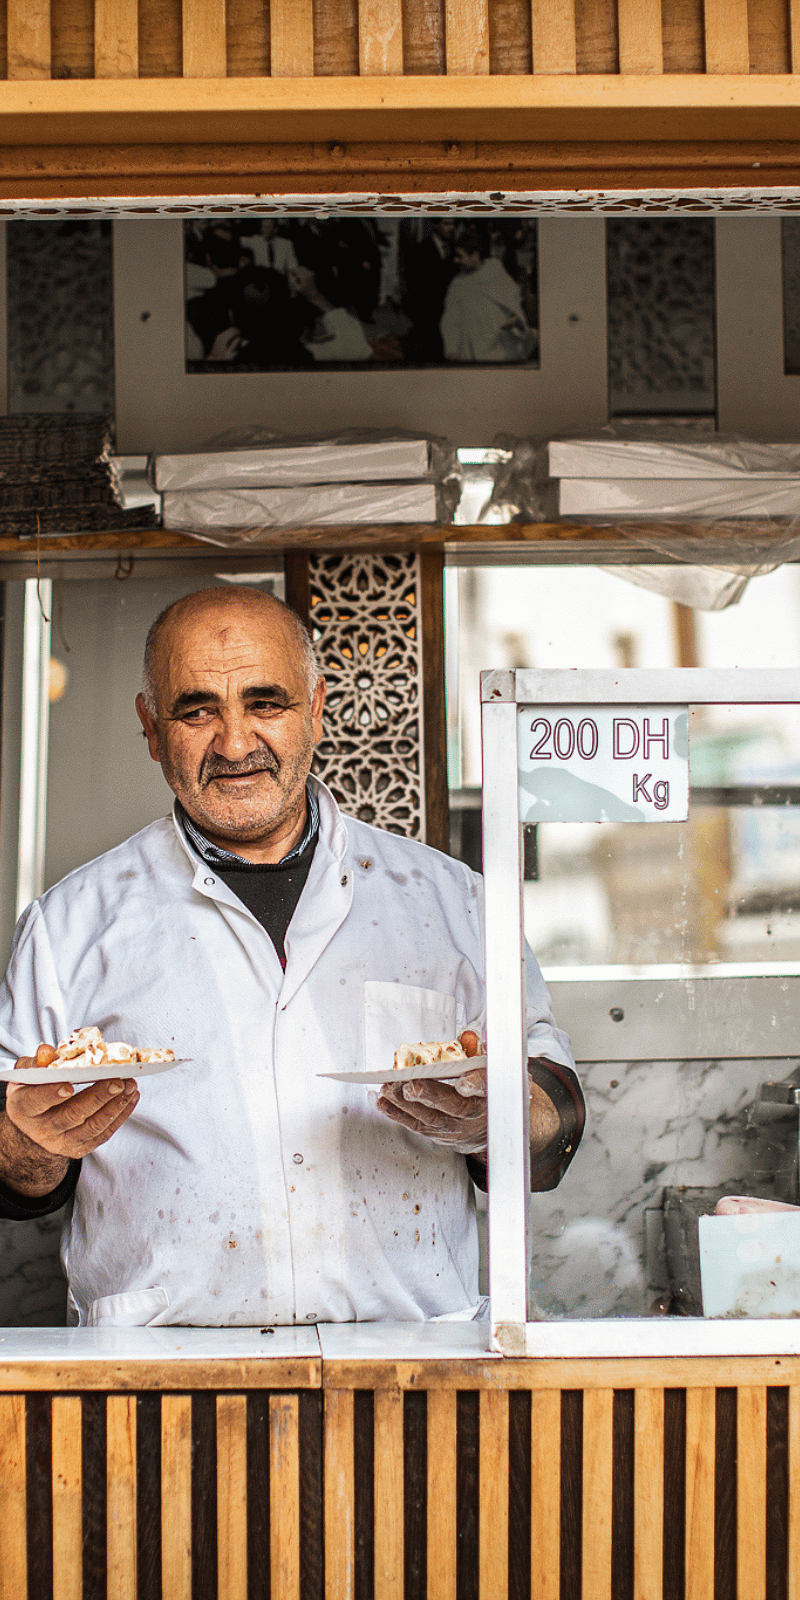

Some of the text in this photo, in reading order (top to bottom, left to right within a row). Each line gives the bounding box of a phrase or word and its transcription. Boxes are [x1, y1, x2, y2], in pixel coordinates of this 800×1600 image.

[529, 717, 669, 760] 200 DH
[632, 773, 670, 810] Kg
